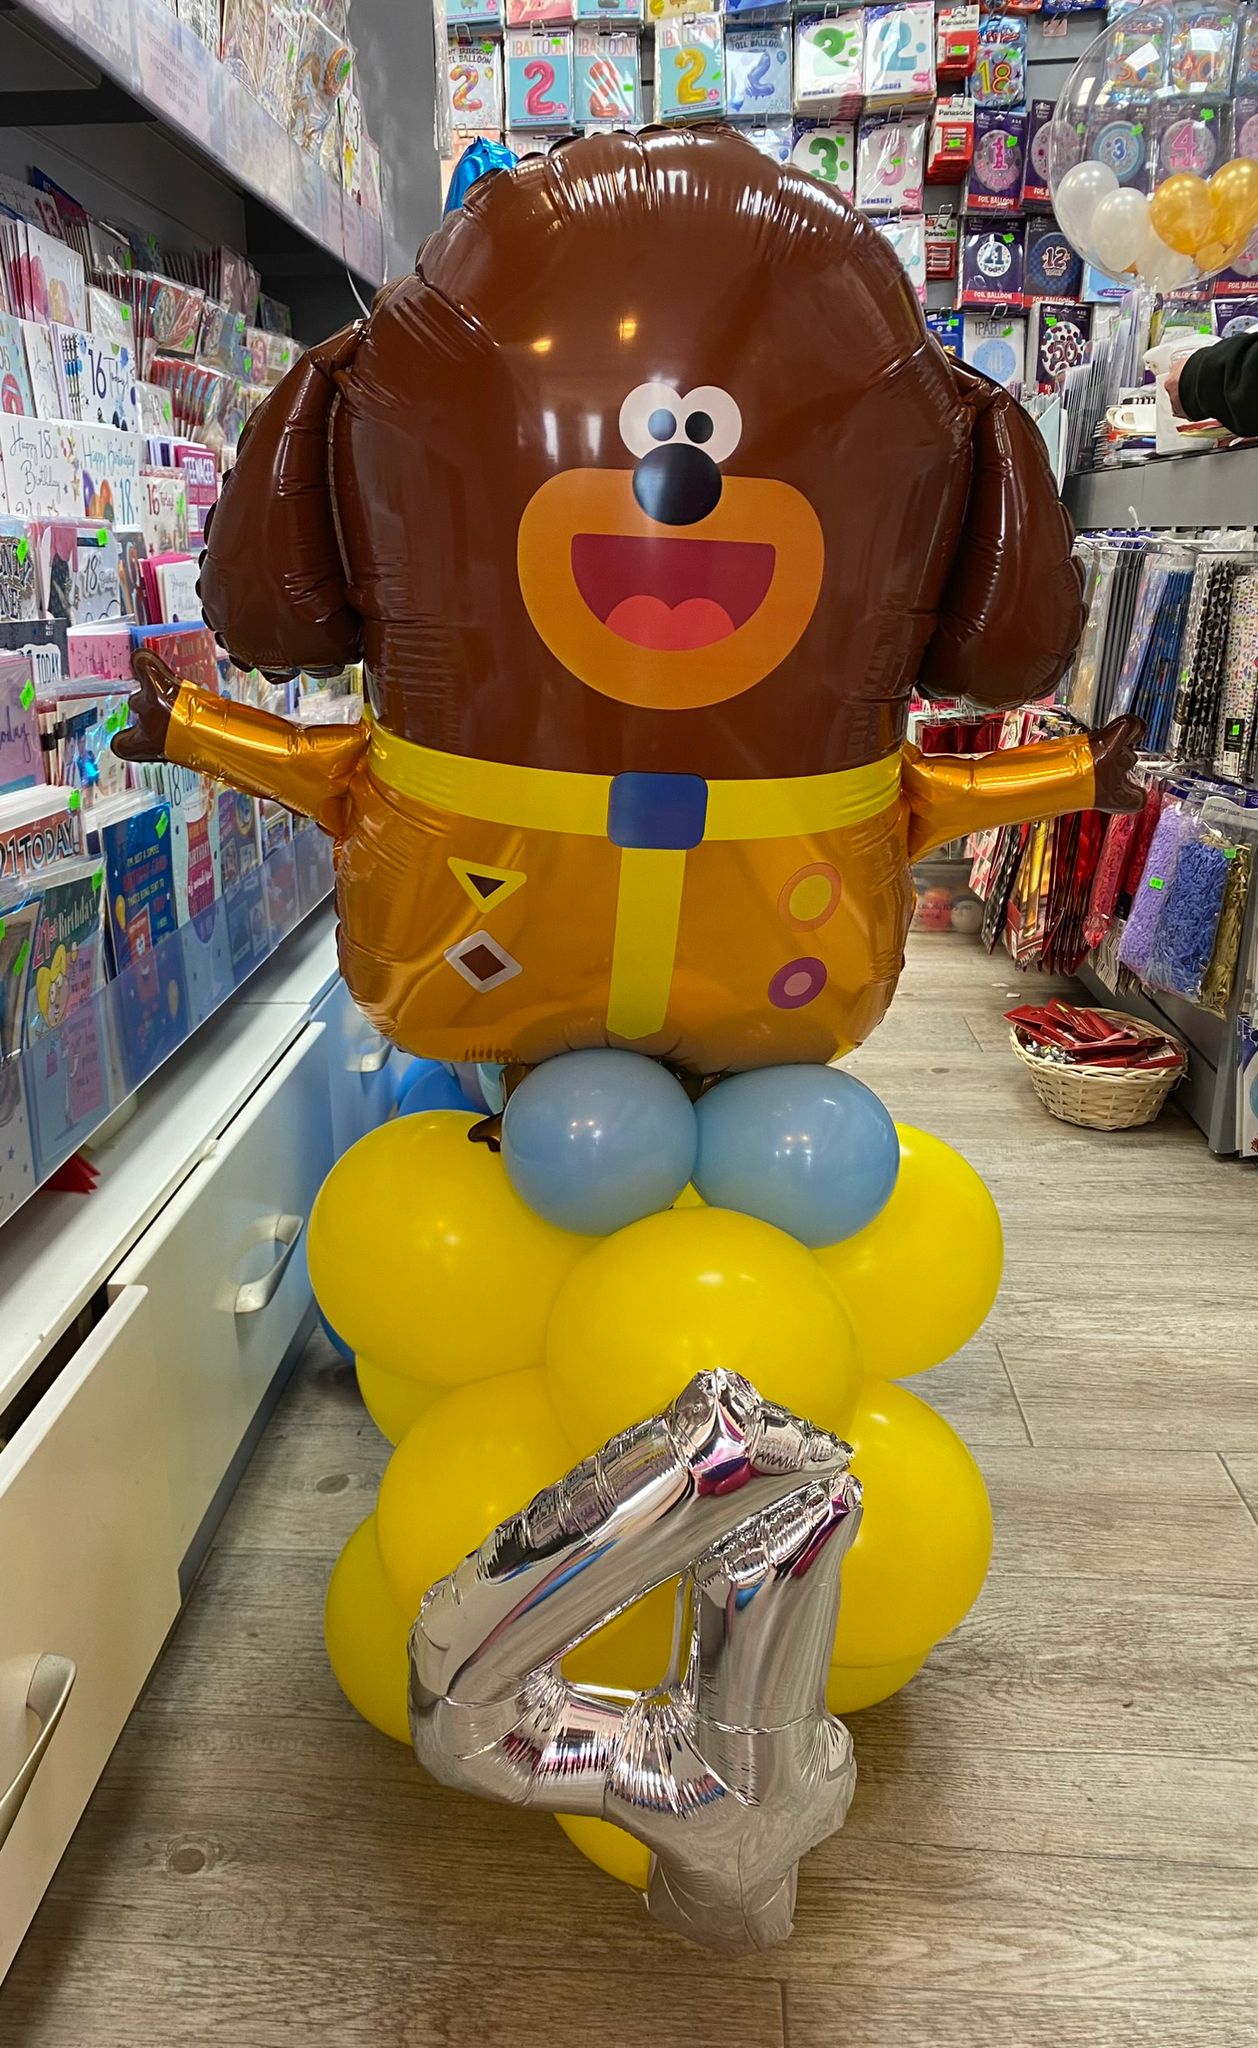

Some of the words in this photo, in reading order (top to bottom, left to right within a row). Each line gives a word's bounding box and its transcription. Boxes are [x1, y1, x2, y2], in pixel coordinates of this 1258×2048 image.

[458, 55, 491, 64] BALLOON
[879, 21, 917, 70] 2
[449, 65, 482, 111] 2
[524, 60, 556, 116] 2
[674, 48, 707, 105] 2
[977, 60, 1012, 95] 18
[939, 108, 972, 116] Panasonic
[809, 137, 838, 183] 3
[876, 134, 907, 186] 3
[989, 136, 1008, 170] 1
[1112, 137, 1126, 161] 3
[1172, 123, 1198, 160] 4
[978, 196, 989, 204] FOIL
[990, 197, 1015, 206] BALLOON
[925, 229, 955, 237] Panaso
[1042, 246, 1069, 269] 12
[1227, 281, 1240, 289] FOIL
[88, 348, 107, 399] 16
[10, 420, 38, 466] Happy
[21, 459, 60, 504] Birthday
[119, 478, 135, 526] 18
[168, 764, 182, 808] 18
[0, 832, 19, 880] 21
[18, 814, 81, 875] TODAY!
[33, 916, 58, 969] 21st
[407, 1367, 863, 1957] 4
